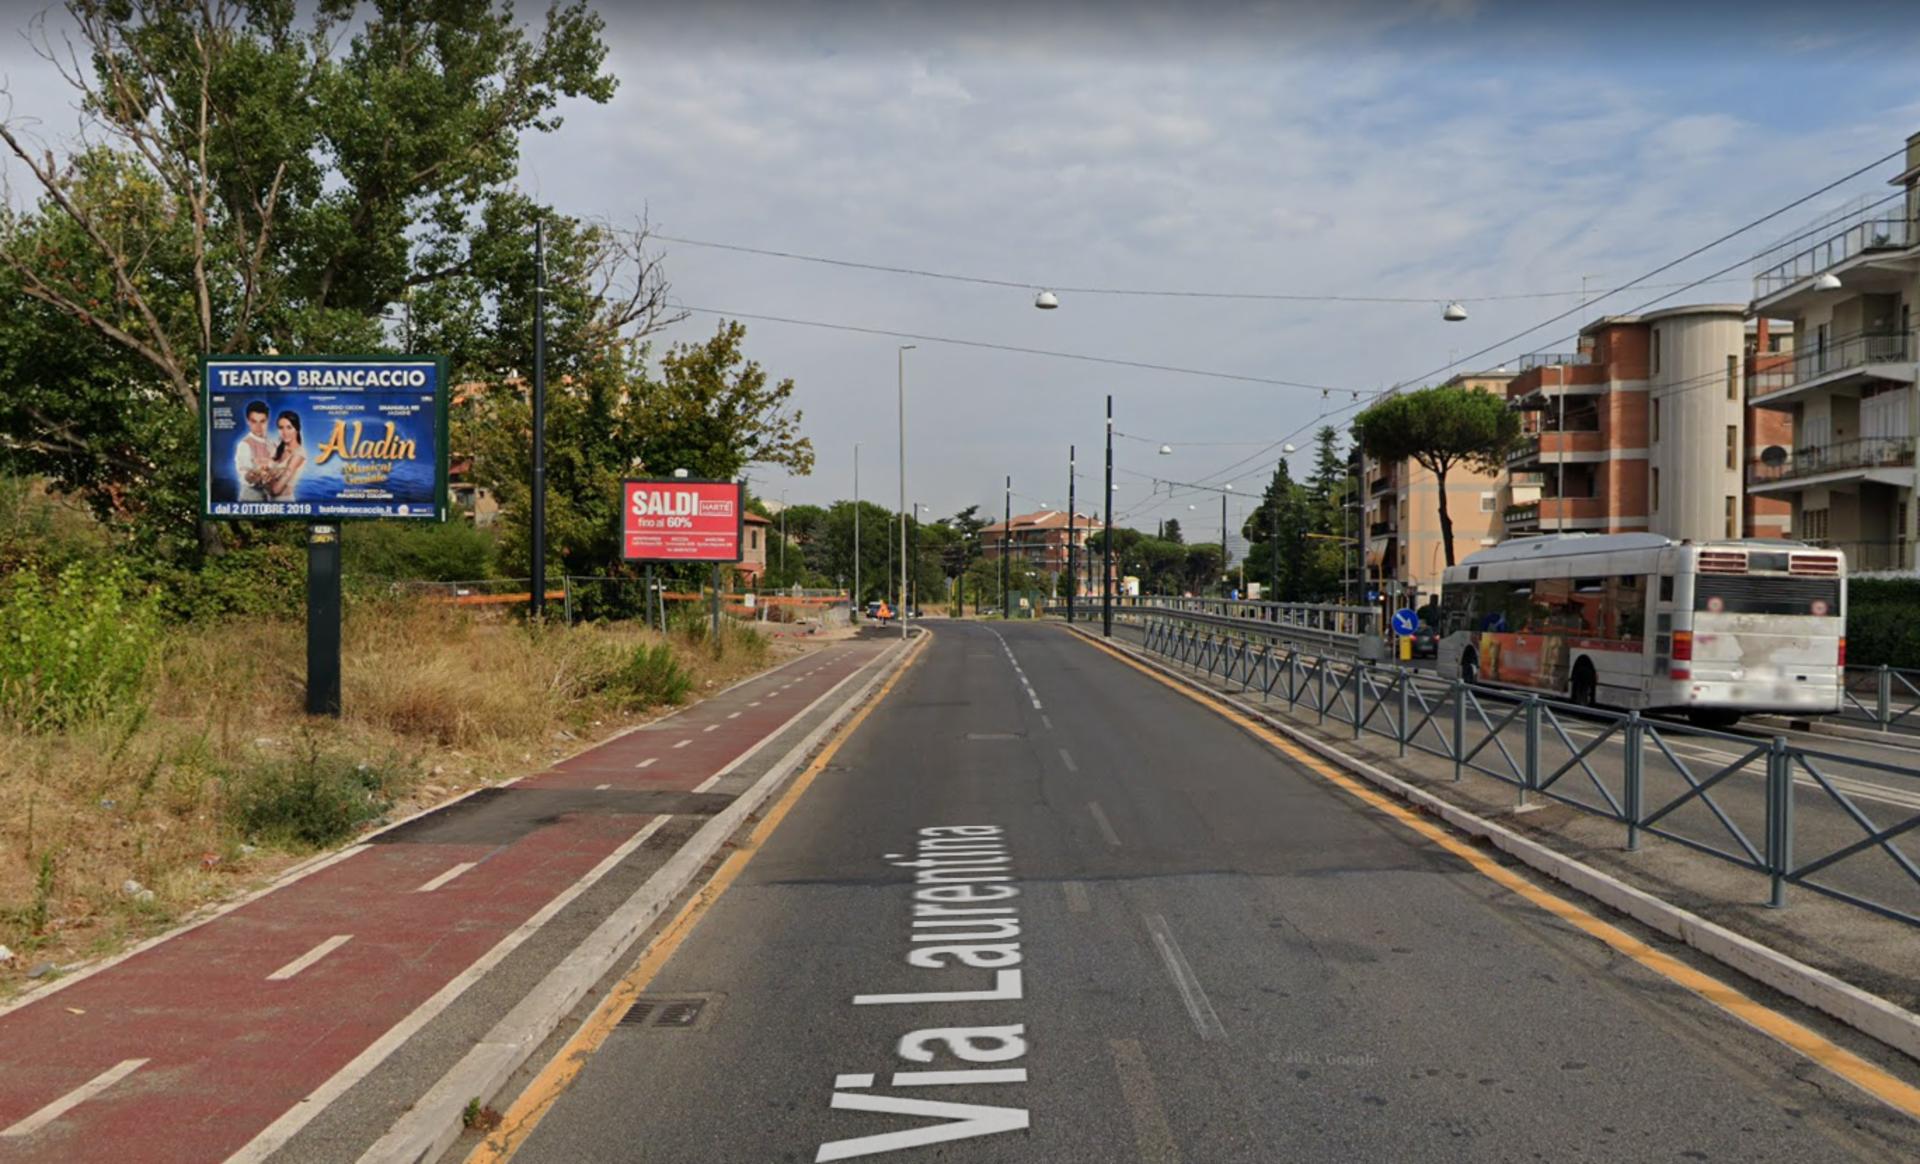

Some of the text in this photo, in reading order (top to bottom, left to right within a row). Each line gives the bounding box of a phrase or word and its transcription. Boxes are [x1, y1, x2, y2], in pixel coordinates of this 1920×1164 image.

[218, 370, 426, 387] TEATRO BRANCACCIO
[315, 419, 416, 464] Aladin
[215, 504, 312, 514] dal 2 OTTOBRE 2019
[632, 490, 698, 516] SALDI
[667, 516, 693, 528] 60%
[815, 825, 1030, 1163] Via Laurentina
